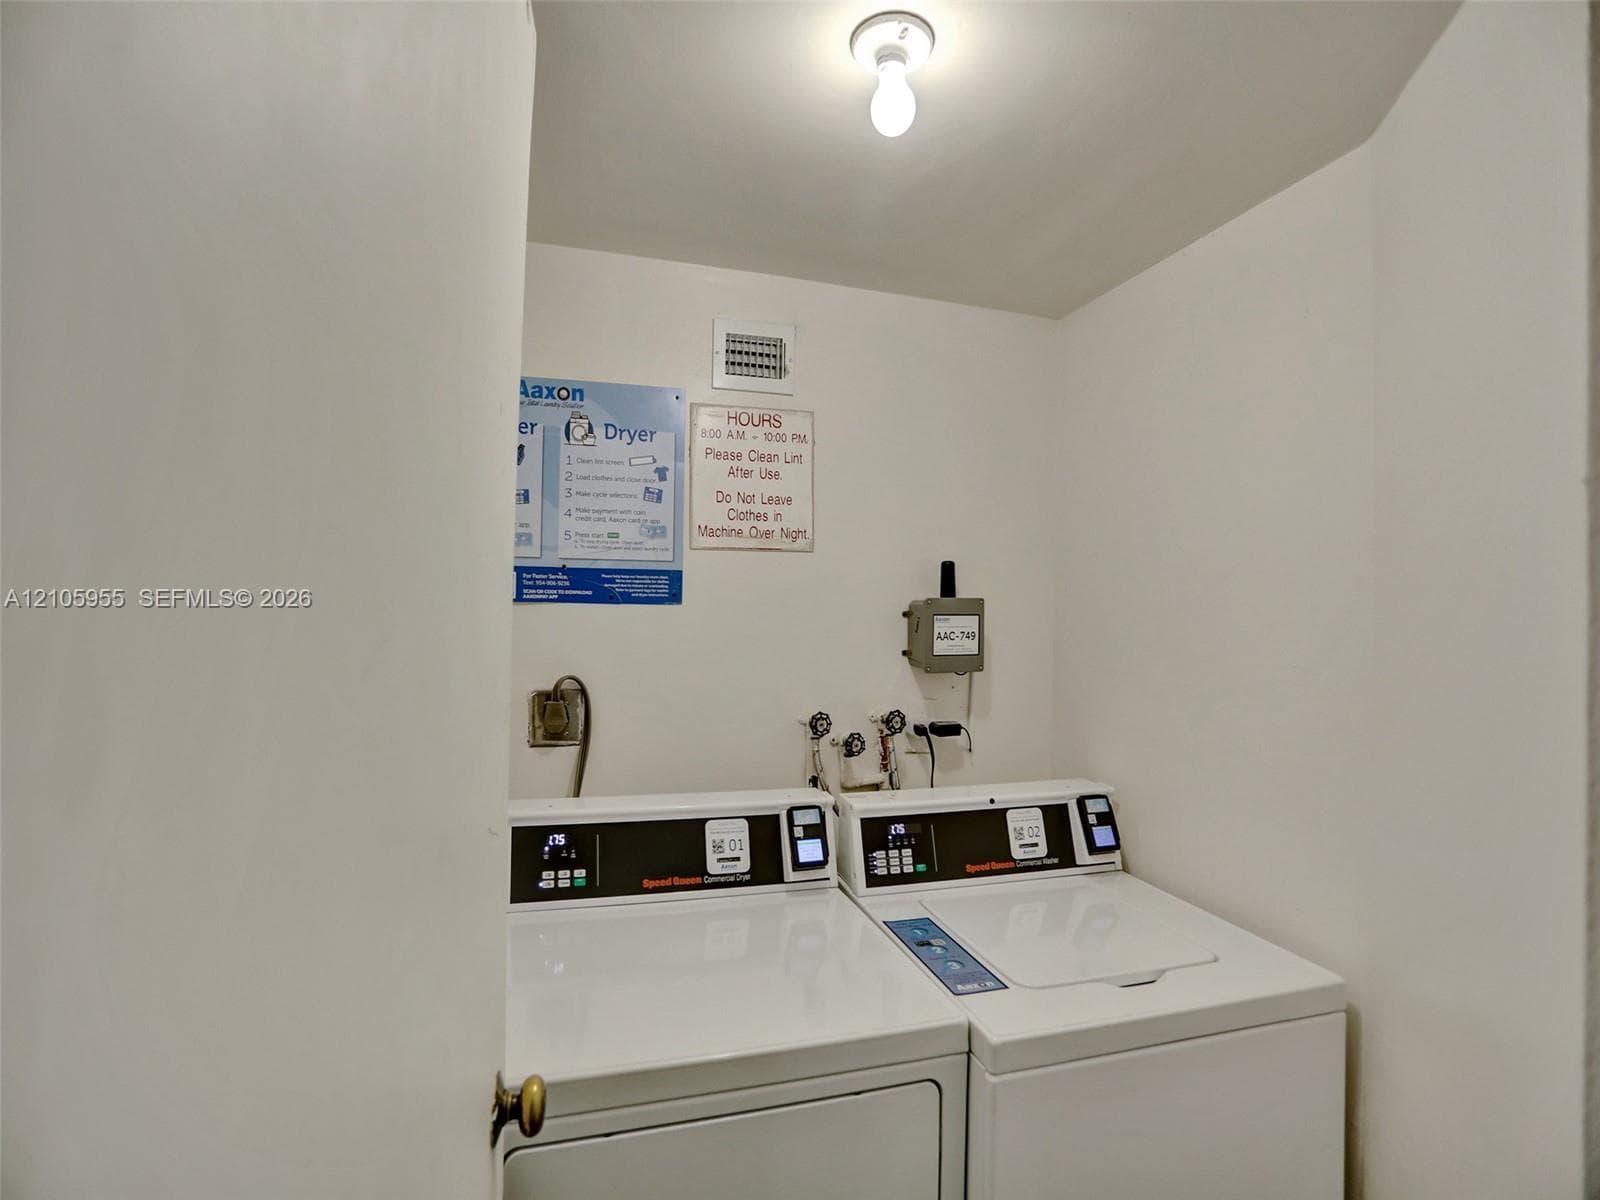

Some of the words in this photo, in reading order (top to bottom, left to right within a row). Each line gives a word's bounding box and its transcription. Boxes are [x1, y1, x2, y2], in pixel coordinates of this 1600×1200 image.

[520, 379, 584, 402] Aaxon
[727, 410, 782, 428] HOURS
[604, 423, 657, 446] Dryer
[700, 428, 722, 440] 8:00
[726, 430, 748, 441] A.M.
[763, 432, 788, 443] 10:00
[565, 455, 572, 466] 1
[576, 457, 594, 465] Clean
[705, 447, 743, 462] Please
[748, 449, 780, 464] Clean
[784, 452, 803, 464] Lint
[564, 471, 574, 482] 2
[728, 466, 754, 479] After
[760, 468, 783, 480] Use.
[564, 488, 573, 498] 3
[592, 490, 608, 498] cycle
[716, 490, 732, 504] Do
[737, 492, 756, 504] Not
[761, 493, 793, 506] Leave
[564, 508, 572, 518] 4
[592, 508, 618, 516] payment
[727, 508, 769, 522] Clothes
[774, 510, 782, 522] in
[564, 530, 572, 541] 5
[698, 525, 744, 538] Machine
[748, 526, 776, 540] Over
[780, 528, 810, 542] Night.
[936, 631, 976, 641] AAC-749
[1027, 826, 1041, 838] 02
[728, 838, 744, 852] 01
[965, 862, 990, 873] Speed
[642, 878, 672, 889] Speed
[703, 874, 736, 884] Commercial
[736, 873, 752, 883] Dryer
[948, 962, 962, 970] 3
